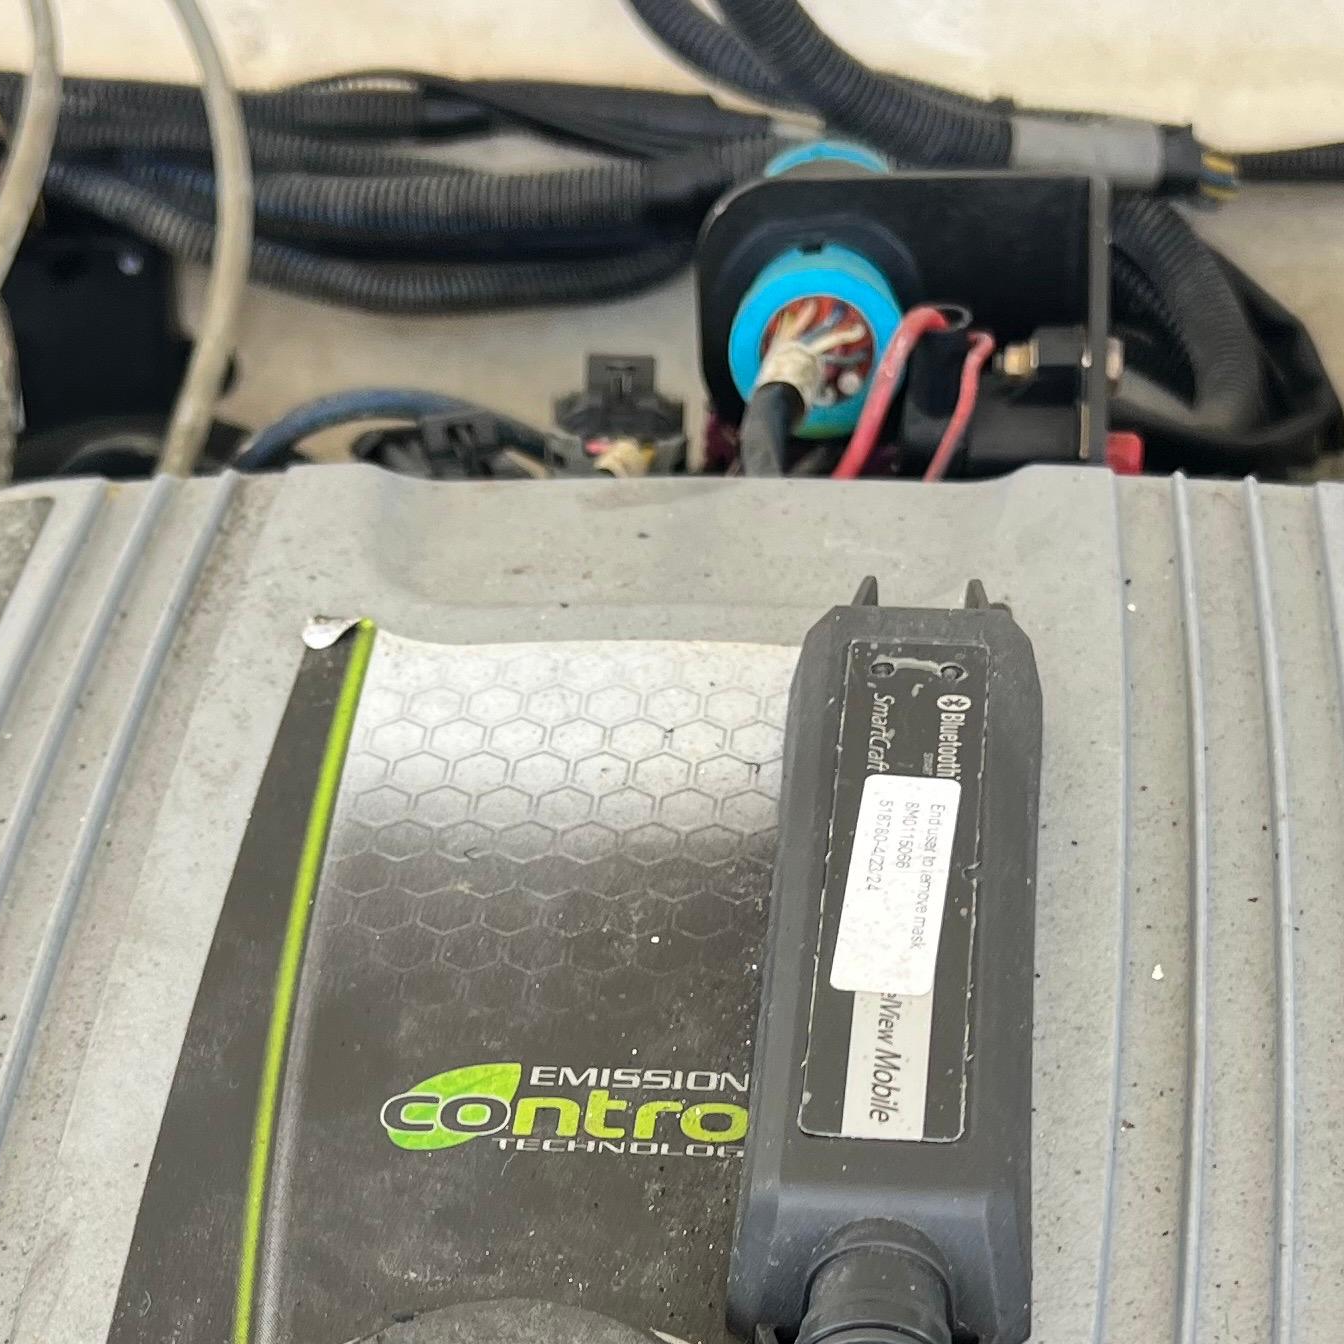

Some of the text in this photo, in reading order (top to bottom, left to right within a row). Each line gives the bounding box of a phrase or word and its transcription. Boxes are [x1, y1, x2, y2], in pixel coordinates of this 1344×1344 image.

[866, 692, 895, 774] SmartCraft
[929, 803, 946, 825] End
[923, 828, 940, 853] user
[922, 856, 937, 867] to
[910, 916, 927, 950] mask
[529, 1065, 750, 1092] EMISSION
[868, 1048, 902, 1124] Mobile
[379, 1089, 750, 1143] contro
[491, 1137, 746, 1158] TECHNOLOG
